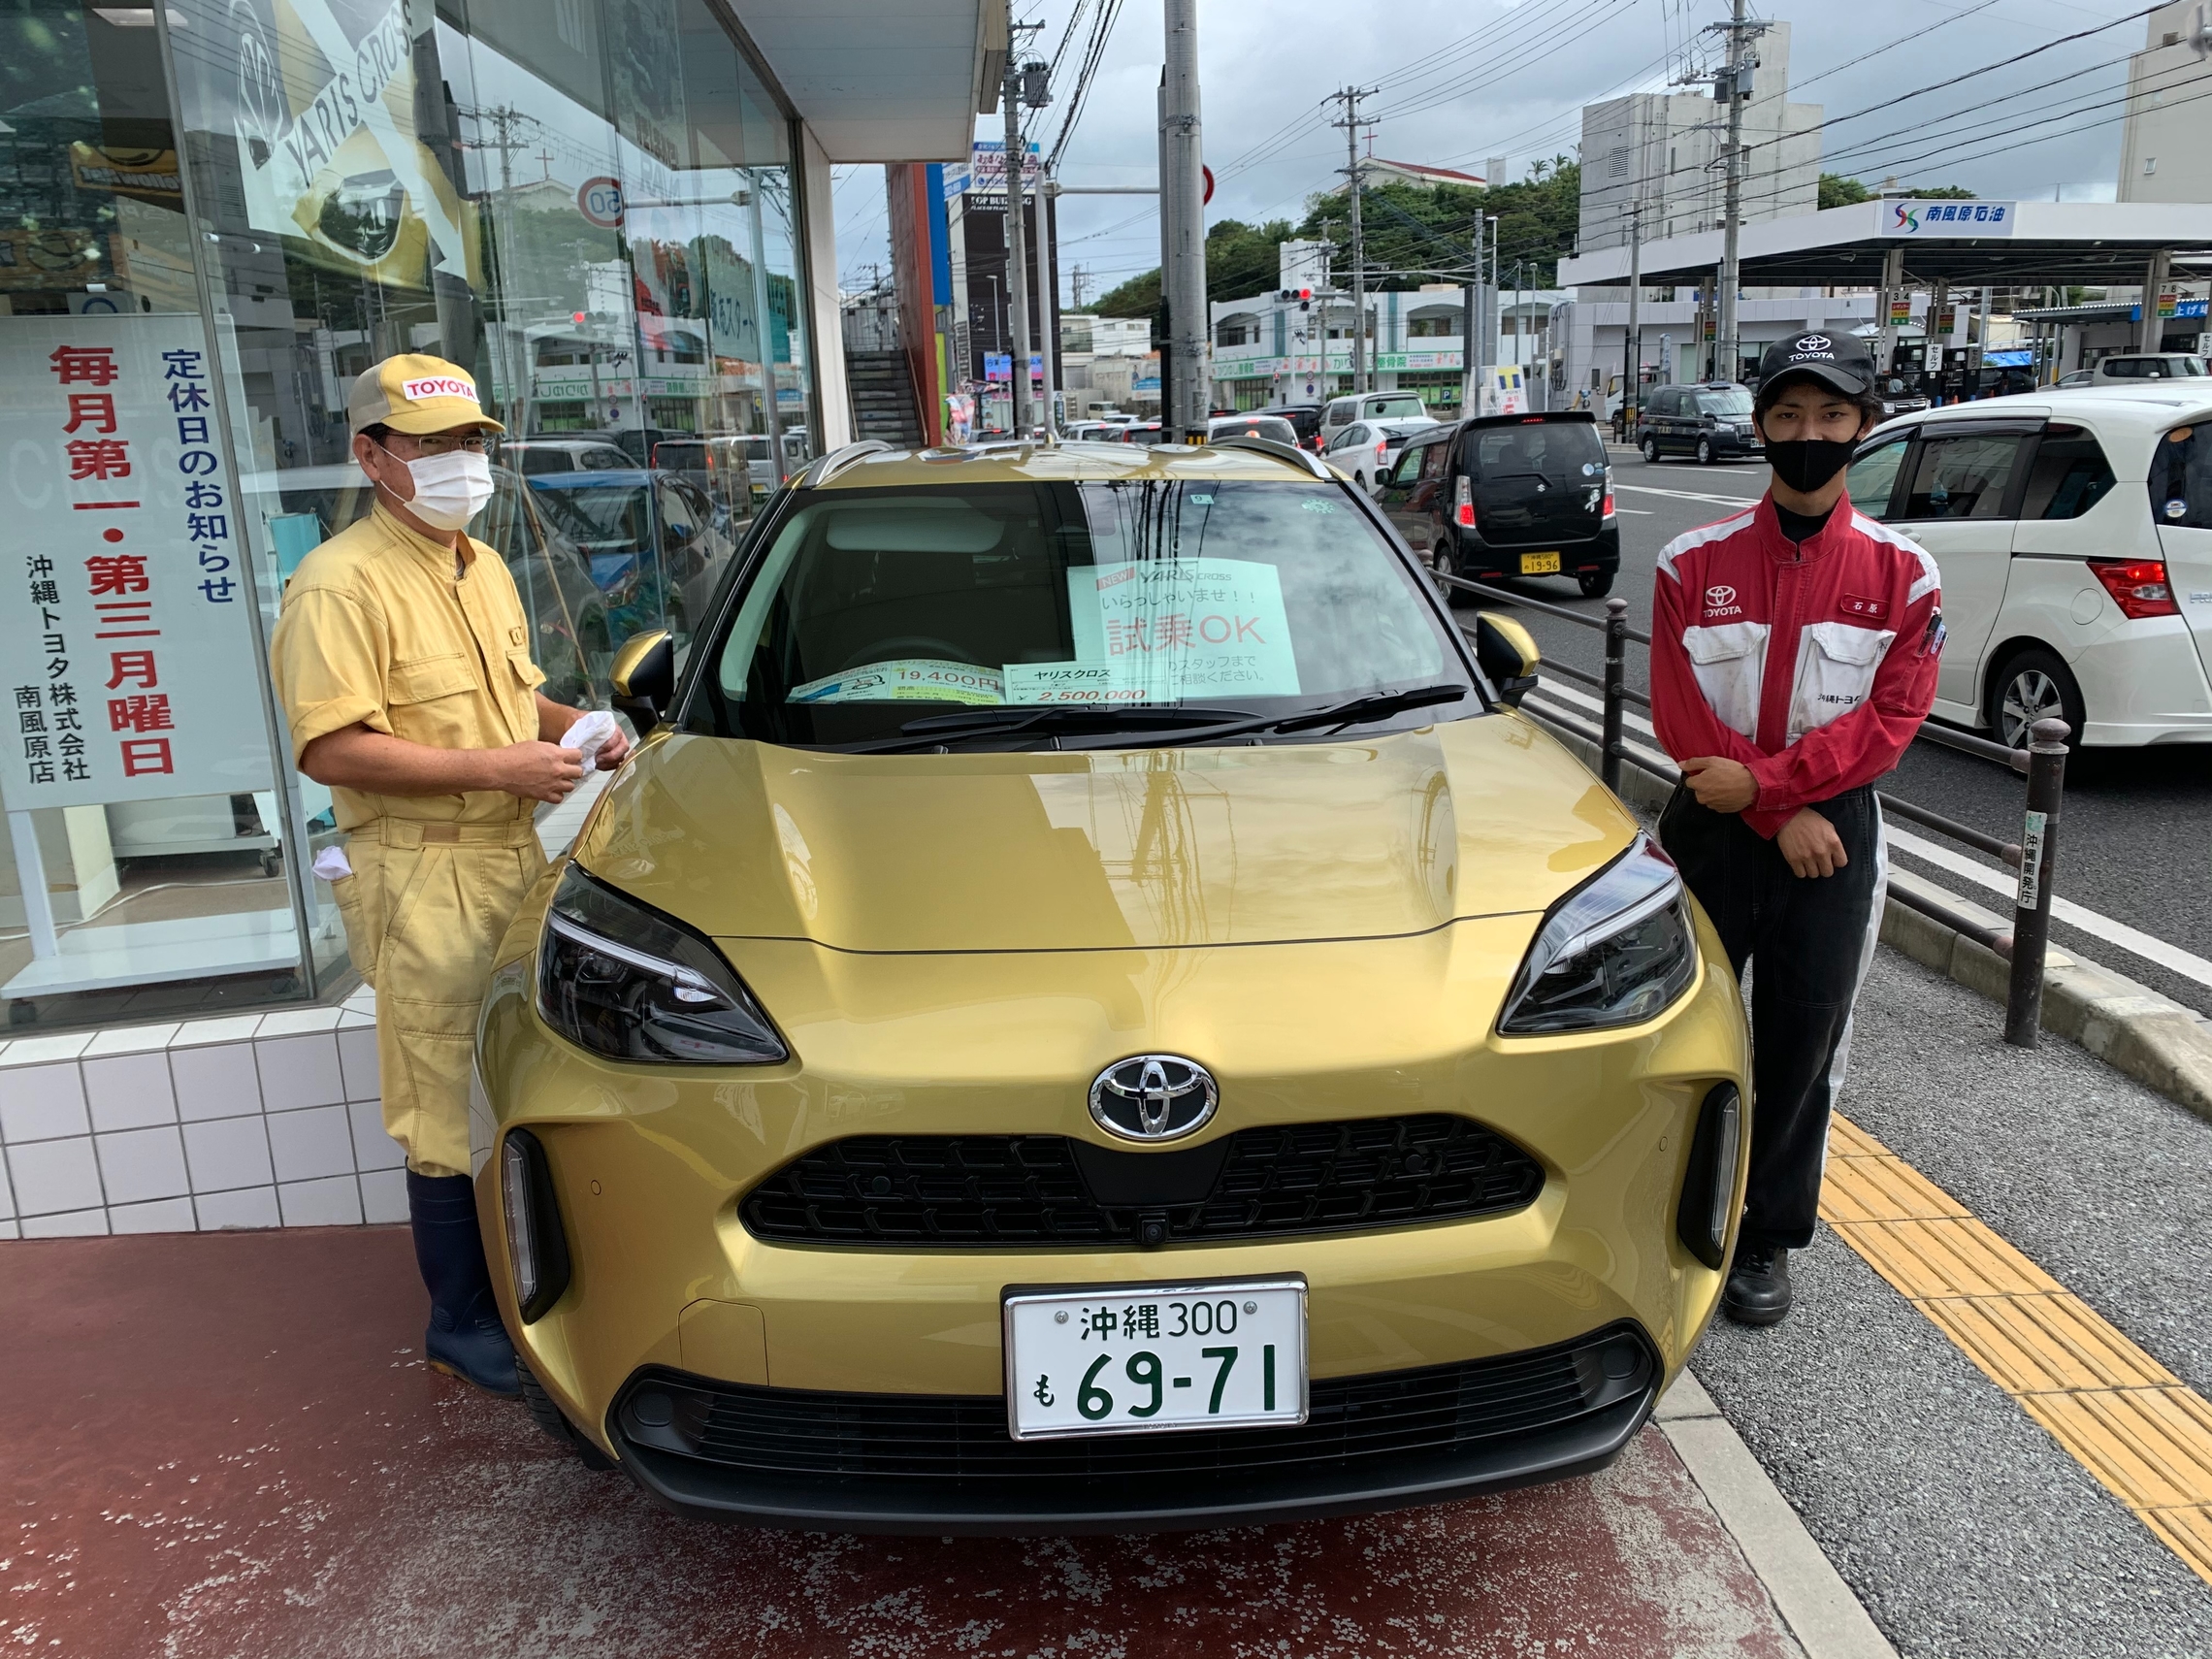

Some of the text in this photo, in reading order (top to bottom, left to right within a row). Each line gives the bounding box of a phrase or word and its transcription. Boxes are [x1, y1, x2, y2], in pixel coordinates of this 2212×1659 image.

[284, 73, 358, 189] YARIS
[1925, 206, 2006, 221] 南風原石油
[1788, 351, 1835, 362] TOYOTA
[407, 379, 476, 399] TOYOTA
[1444, 390, 1450, 399] P
[161, 348, 236, 603] 定休日のお知らせ
[49, 345, 176, 777] 毎月第一・第三月曜日
[1532, 560, 1558, 571] 19-96
[1101, 569, 1232, 588] NEW YARIS CROSS
[2190, 593, 2212, 603] FR
[1704, 605, 1742, 618] TOYOTA
[1853, 602, 1878, 614] 石原
[1106, 612, 1267, 656] 試乗OK
[26, 554, 91, 782] 沖縄トヨタ株式会社
[1034, 669, 1111, 680] ヤリスクロス
[898, 670, 999, 691] 19,400円
[1038, 690, 1146, 701] 2,500,000
[13, 684, 56, 784] 南風原店
[1080, 1300, 1238, 1341] 沖縄300
[1033, 1344, 1276, 1420] も 69-71
